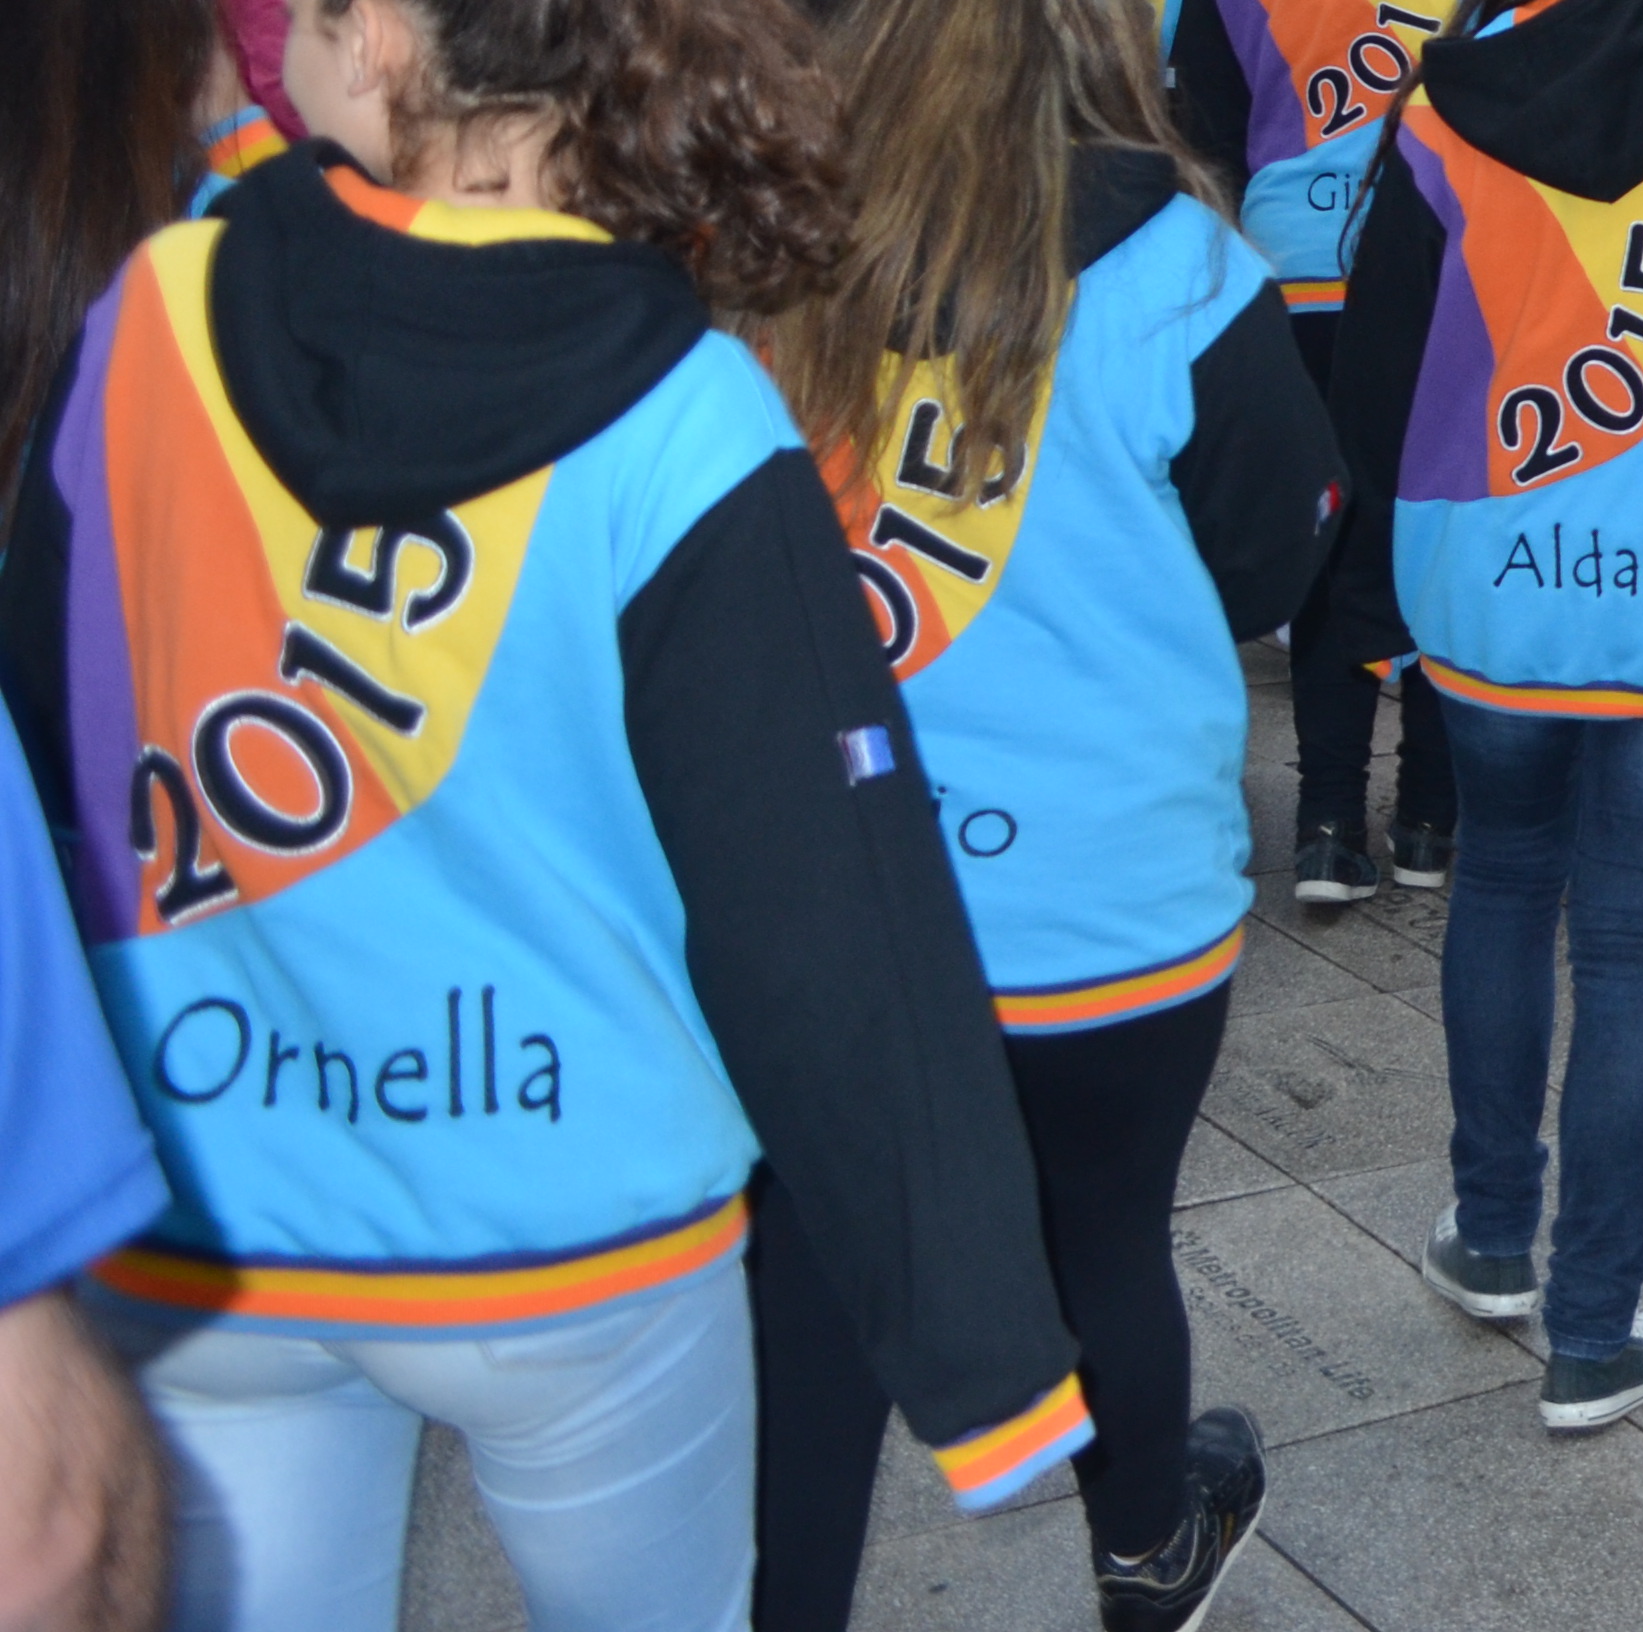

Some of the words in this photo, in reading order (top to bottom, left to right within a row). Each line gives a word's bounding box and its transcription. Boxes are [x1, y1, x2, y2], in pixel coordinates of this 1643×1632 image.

[1307, 172, 1364, 211] Gi
[131, 508, 475, 926] 2015
[152, 984, 563, 1123] Ornella
[1178, 1247, 1327, 1362] Metropolitan
[1318, 1361, 1376, 1401] Life
